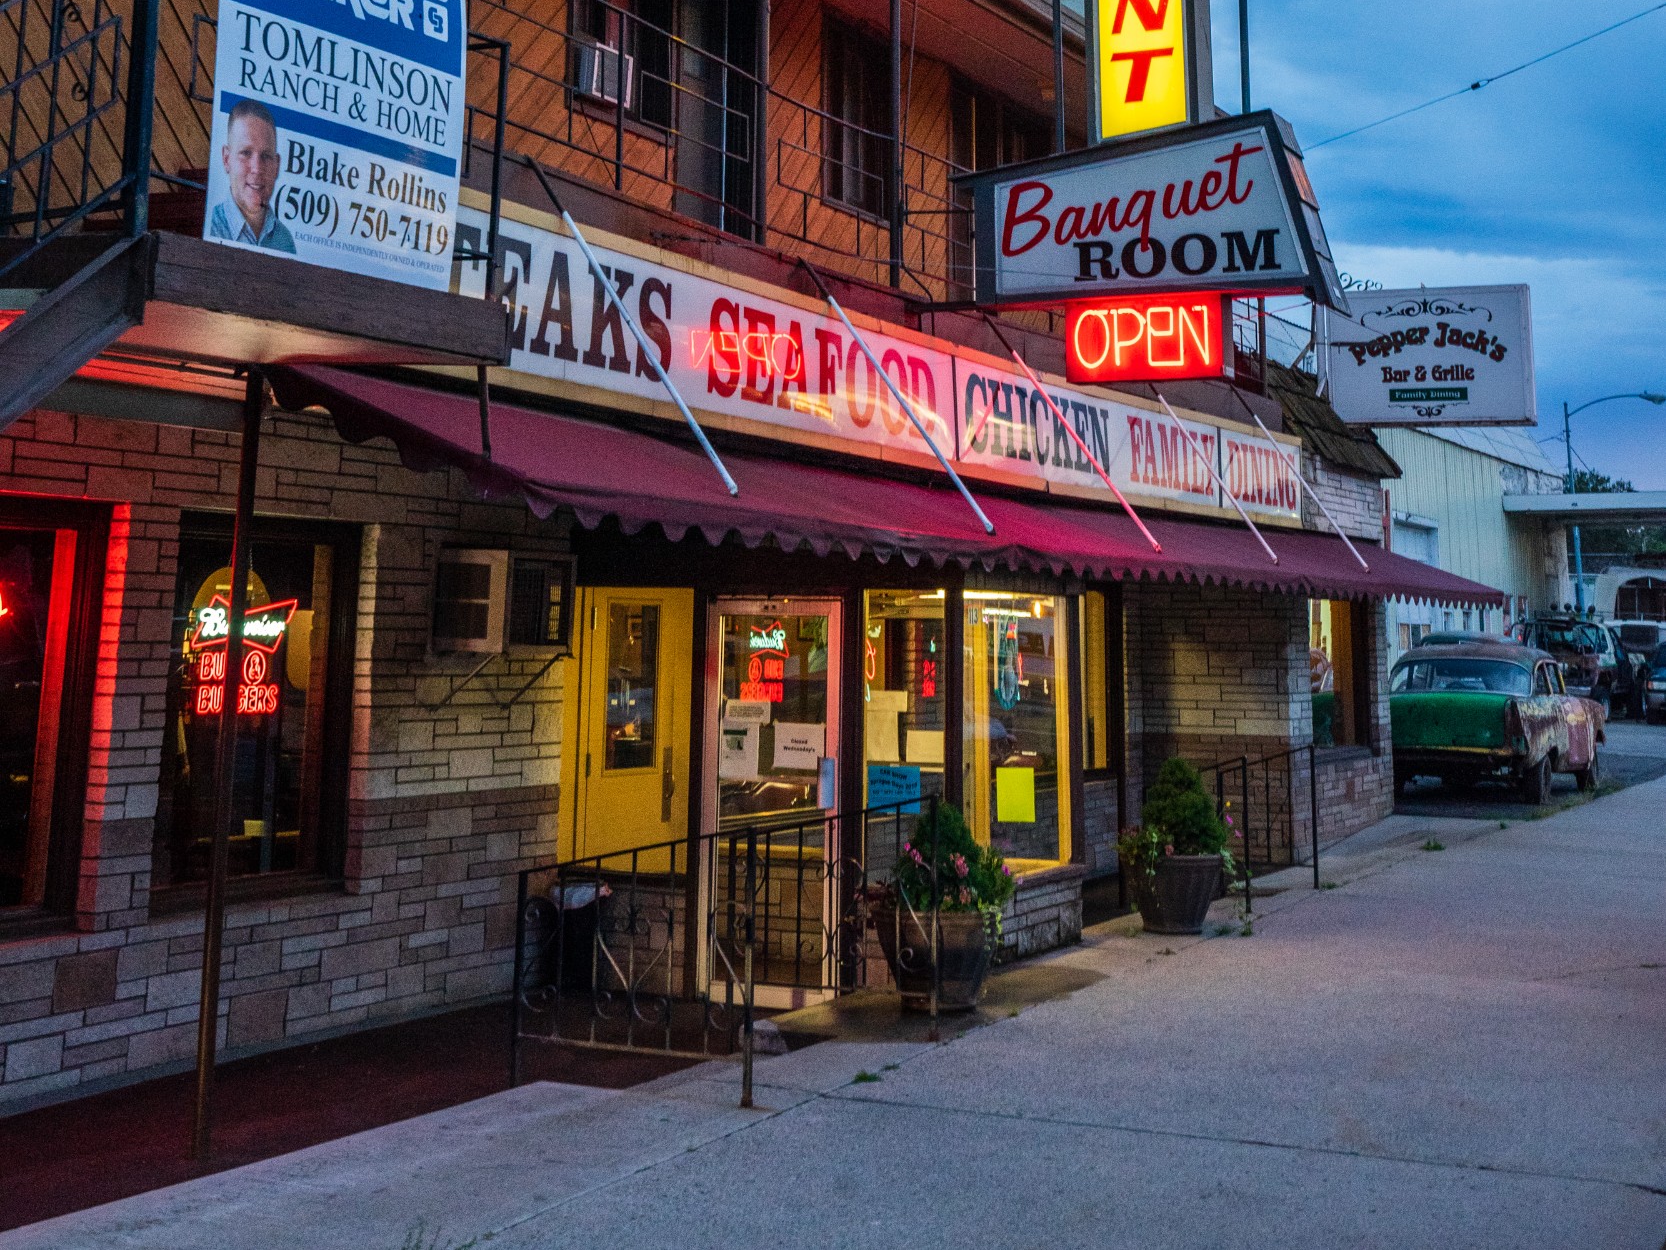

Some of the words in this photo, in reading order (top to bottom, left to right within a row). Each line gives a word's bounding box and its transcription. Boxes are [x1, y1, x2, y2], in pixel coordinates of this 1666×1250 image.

[236, 10, 453, 116] TOMLINSON
[238, 56, 340, 115] RANCH
[348, 92, 367, 123] &
[375, 98, 446, 147] HOME
[285, 139, 360, 190] Blake
[366, 161, 447, 214] Rollins
[1001, 142, 1263, 257] Banquet
[274, 184, 339, 238] (509)
[349, 201, 449, 256] 750-7119
[295, 231, 313, 243] EACH
[313, 236, 334, 248] OFFICE
[335, 240, 341, 250] IS
[342, 242, 389, 260] INDEPENDENTLY
[389, 253, 410, 266] OWNED
[416, 260, 445, 273] OPERATED
[1073, 229, 1281, 281] ROOM
[706, 297, 936, 439] SEAFOOD
[1074, 305, 1209, 370] OPEN
[1348, 326, 1429, 366] Pepper
[1433, 321, 1508, 363] Jack's
[1381, 366, 1410, 383] Bar
[1414, 365, 1427, 382] &
[1431, 364, 1475, 381] Grille
[1395, 391, 1427, 399] Family
[1430, 390, 1460, 398] Dining
[965, 372, 1111, 479] CHICKEN
[1127, 415, 1215, 497] FAMILY
[1226, 439, 1297, 510] DINING
[197, 684, 278, 713] BUGERS
[783, 746, 815, 754] Wednesday's
